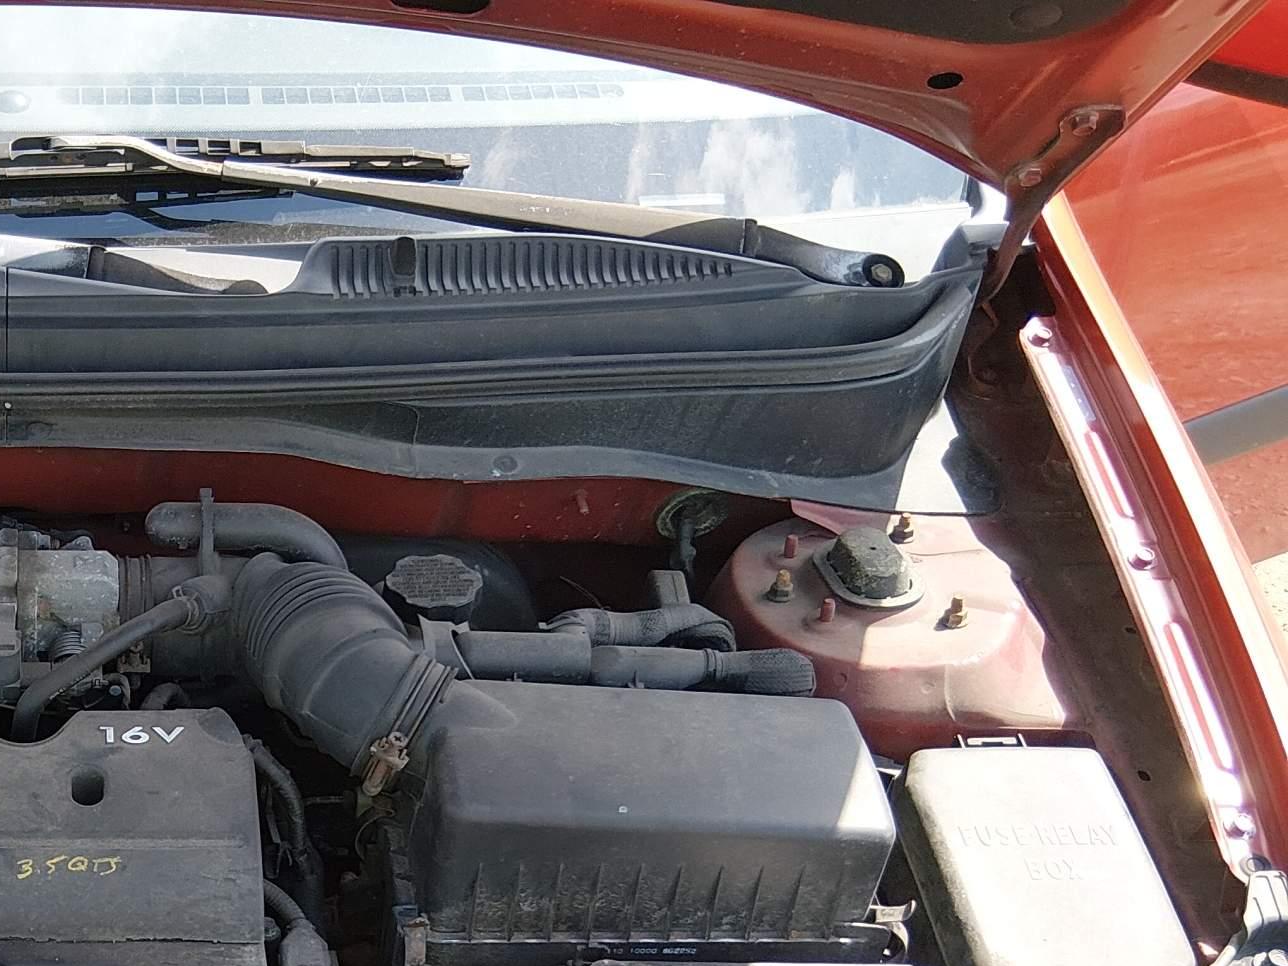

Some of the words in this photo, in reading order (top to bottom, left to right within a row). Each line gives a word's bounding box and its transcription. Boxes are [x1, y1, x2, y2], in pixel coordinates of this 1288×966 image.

[98, 725, 186, 745] 16V
[958, 824, 1029, 847] FUSE
[1033, 823, 1120, 847] RELAY
[1023, 857, 1083, 881] BOX
